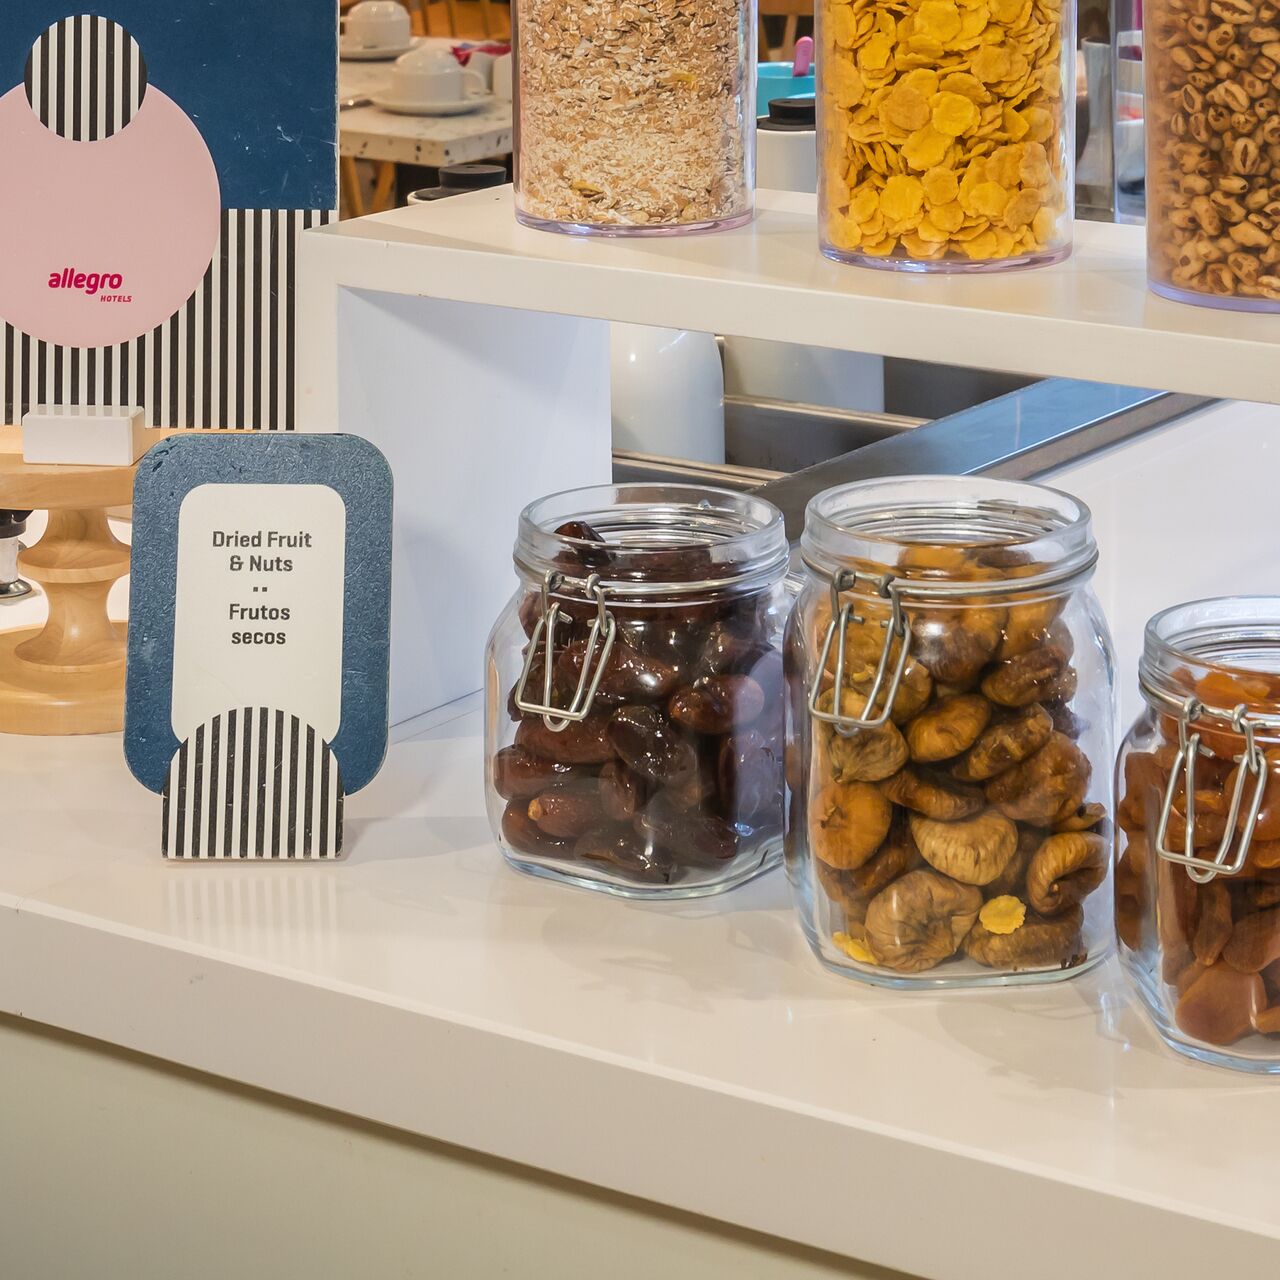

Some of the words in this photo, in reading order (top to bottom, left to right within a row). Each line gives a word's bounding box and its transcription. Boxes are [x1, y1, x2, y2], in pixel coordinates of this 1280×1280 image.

[48, 268, 123, 295] allegro
[100, 295, 132, 303] HOTELS
[212, 531, 262, 548] Dried
[267, 531, 312, 548] Fruit
[229, 555, 244, 572] &
[250, 555, 293, 572] Nuts
[229, 603, 291, 621] Frutos
[231, 631, 287, 645] secos
